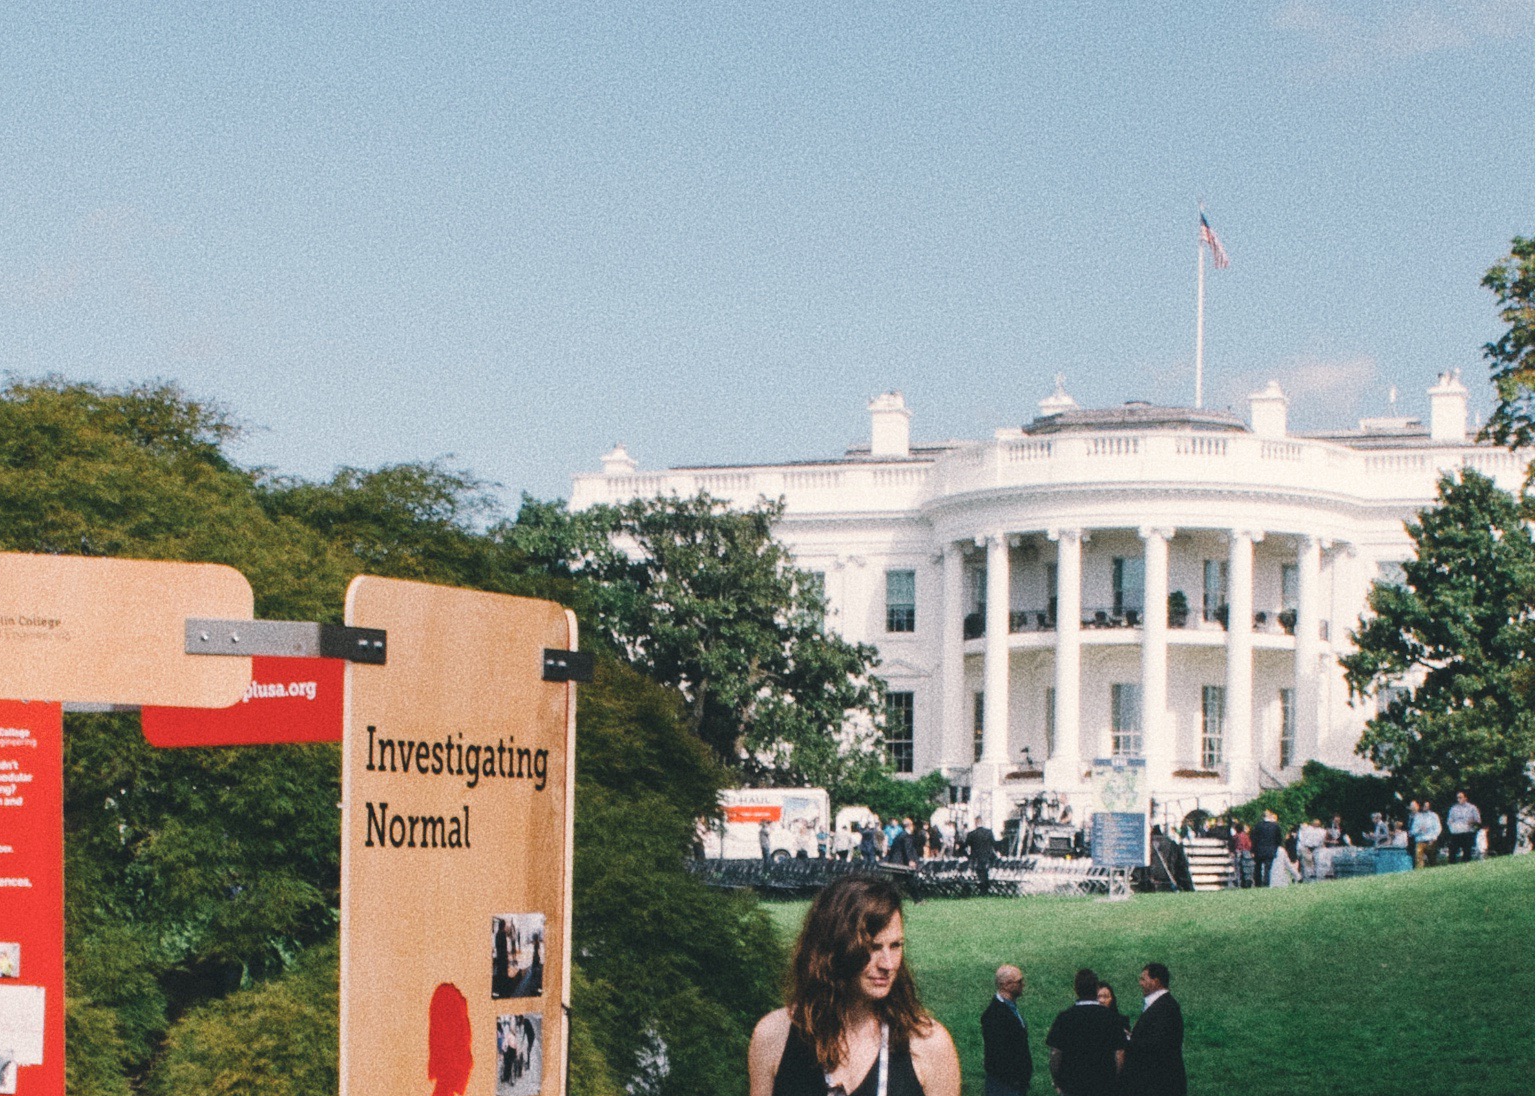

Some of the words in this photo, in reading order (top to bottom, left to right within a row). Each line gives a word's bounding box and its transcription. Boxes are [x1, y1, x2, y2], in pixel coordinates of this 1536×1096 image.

[18, 616, 62, 631] College
[366, 726, 550, 792] Investigating
[364, 802, 470, 849] Normal
